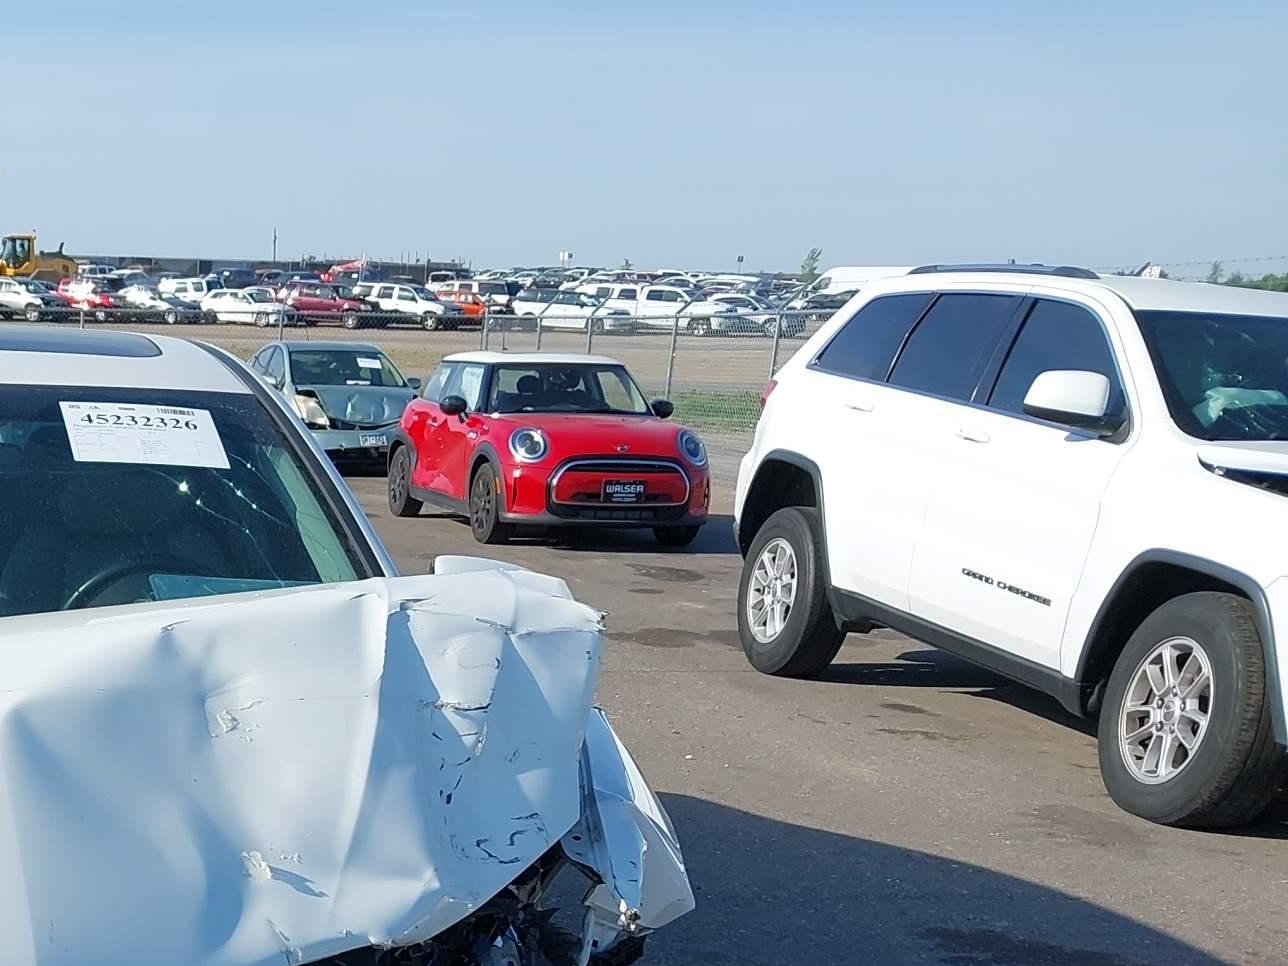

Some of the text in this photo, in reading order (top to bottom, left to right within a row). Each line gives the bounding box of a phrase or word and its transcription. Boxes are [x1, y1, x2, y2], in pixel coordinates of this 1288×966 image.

[80, 413, 198, 431] 45232326
[606, 484, 644, 494] WALSER
[961, 567, 1052, 607] GRAND CHEROKEE
